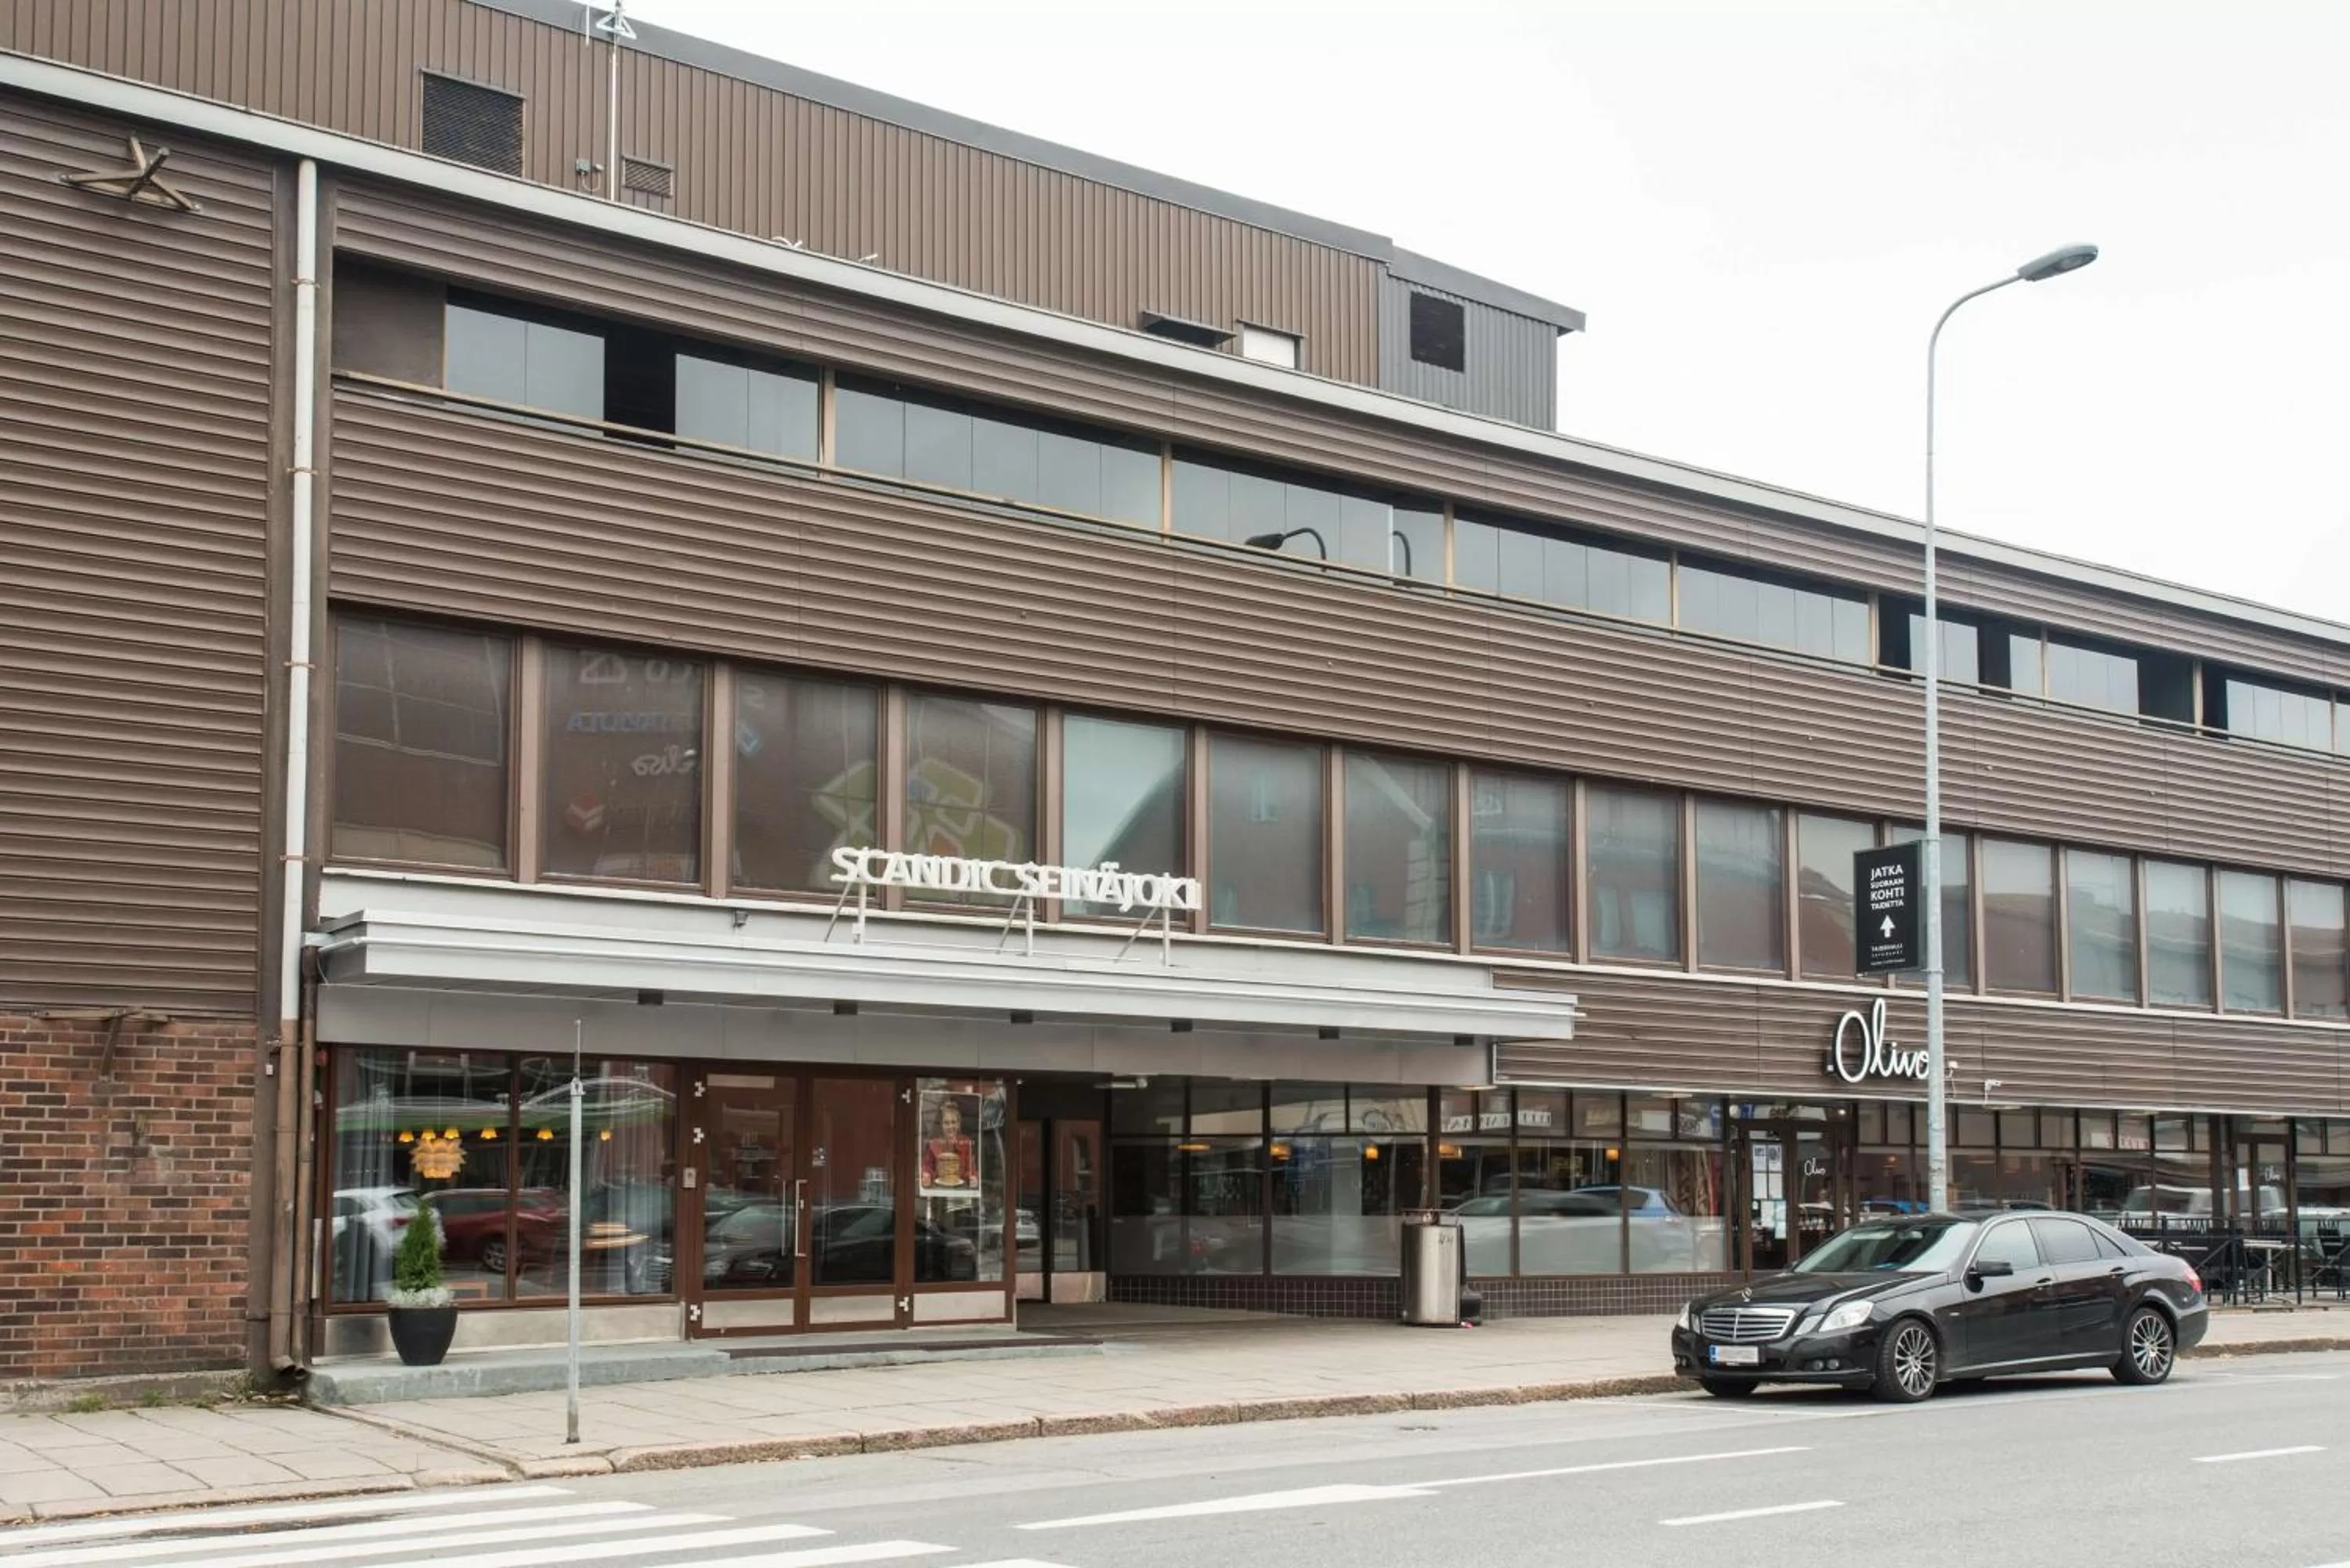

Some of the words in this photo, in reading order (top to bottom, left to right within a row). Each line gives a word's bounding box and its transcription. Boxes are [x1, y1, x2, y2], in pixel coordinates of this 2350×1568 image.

[830, 846, 1018, 894] SCANDIC
[1017, 861, 1202, 912] SEINÄJOKI
[1871, 864, 1904, 881] JATKA
[1871, 887, 1904, 901] KOHTI
